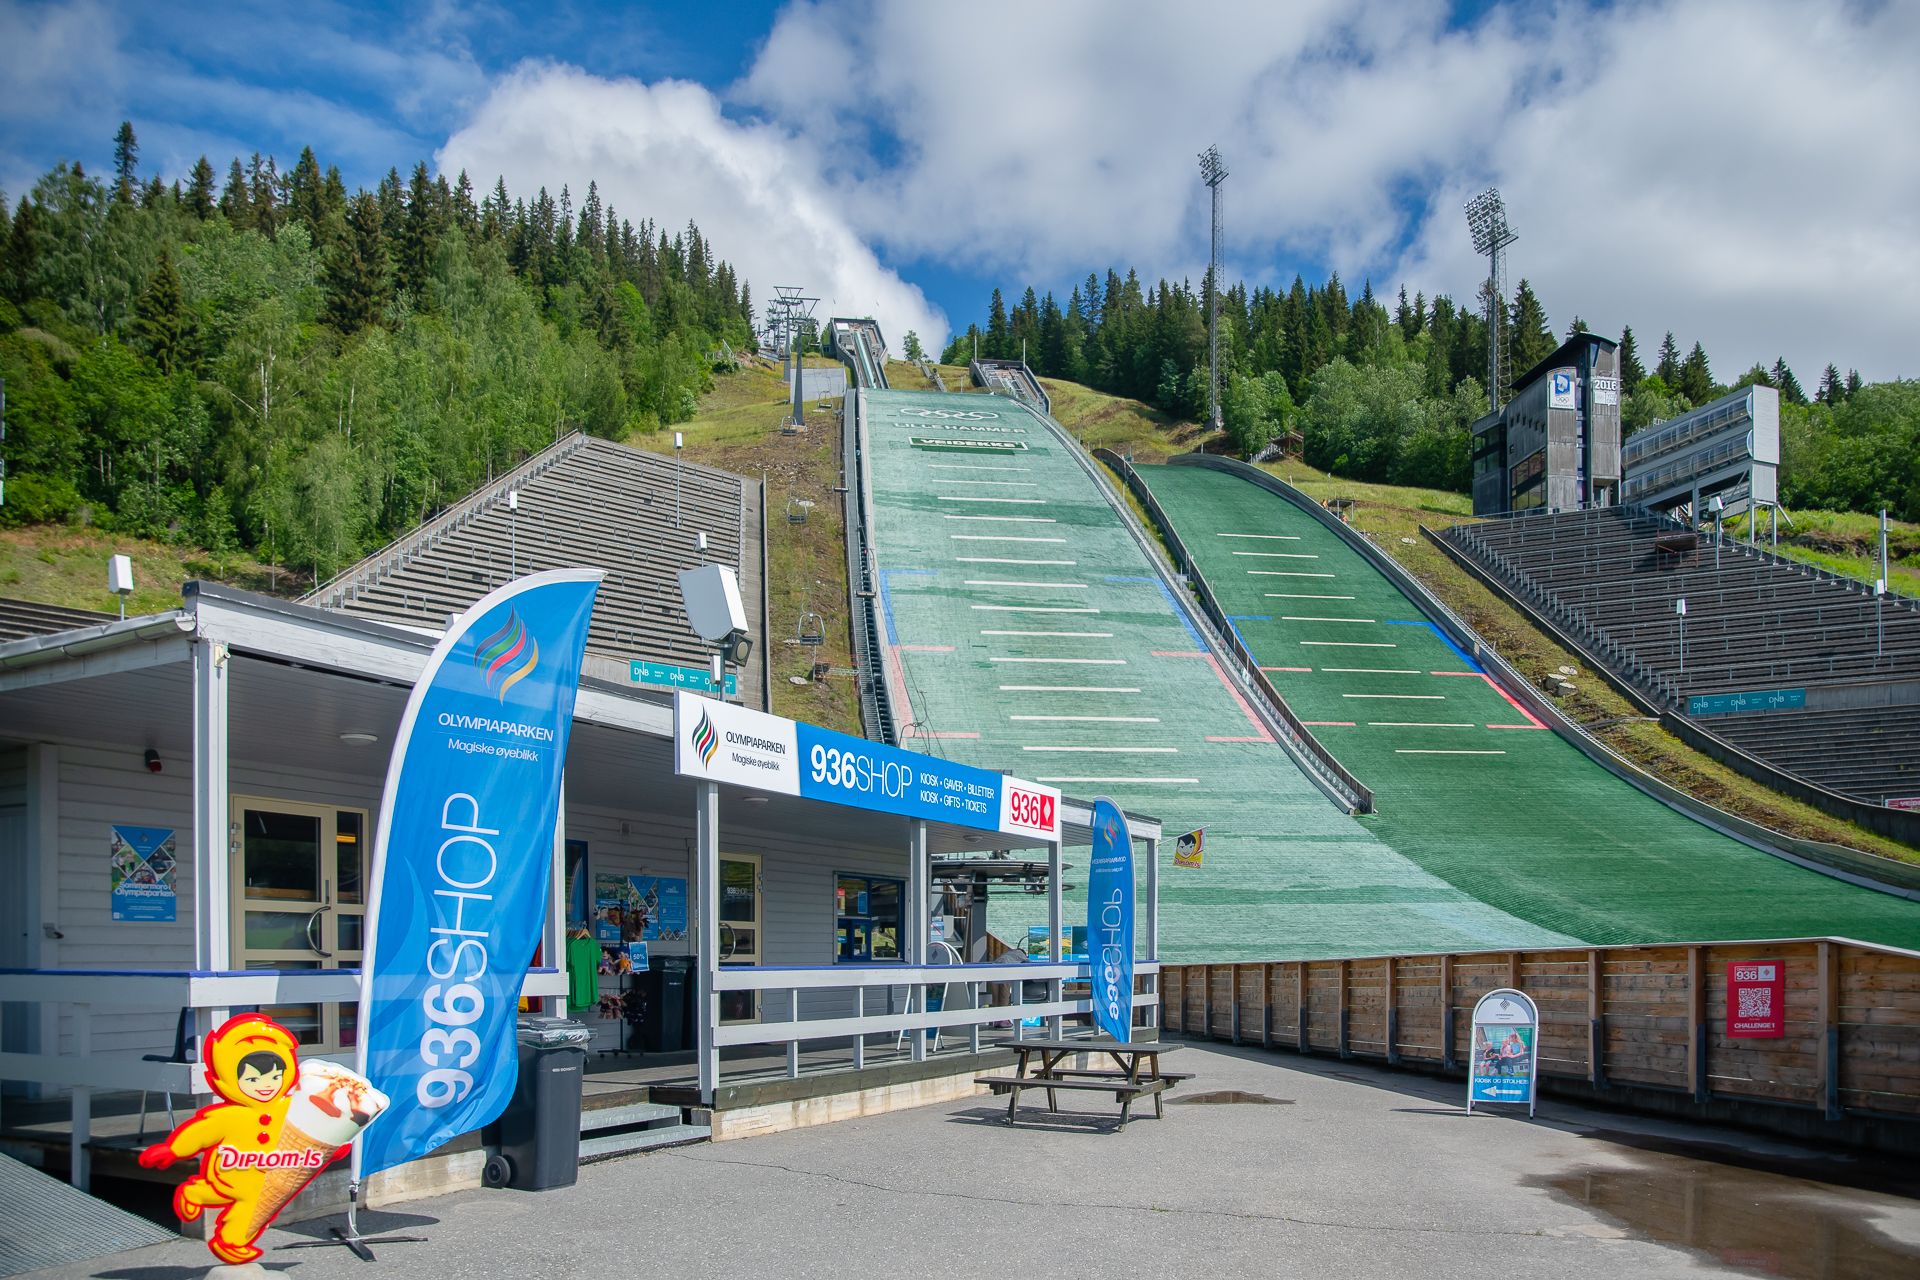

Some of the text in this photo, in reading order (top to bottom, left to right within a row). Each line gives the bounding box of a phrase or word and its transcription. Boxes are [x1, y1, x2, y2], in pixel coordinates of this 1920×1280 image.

[1594, 380, 1617, 391] 2016
[893, 422, 1027, 434] LILLEHAMMER
[438, 712, 554, 742] OLYMPIAPARKEN
[447, 738, 539, 762] Magiske øyeblikk
[725, 731, 786, 755] OLYMPIAPARKEN
[757, 759, 780, 771] øyeblikk
[810, 744, 913, 798] 936SHOP
[920, 772, 995, 799] KIOSK GAVER BILLETTER
[920, 789, 987, 813] KIOSK GIFTS TICKETS
[1011, 791, 1039, 825] 936
[416, 792, 500, 1109] 936SHOP
[1736, 970, 1758, 980] 936
